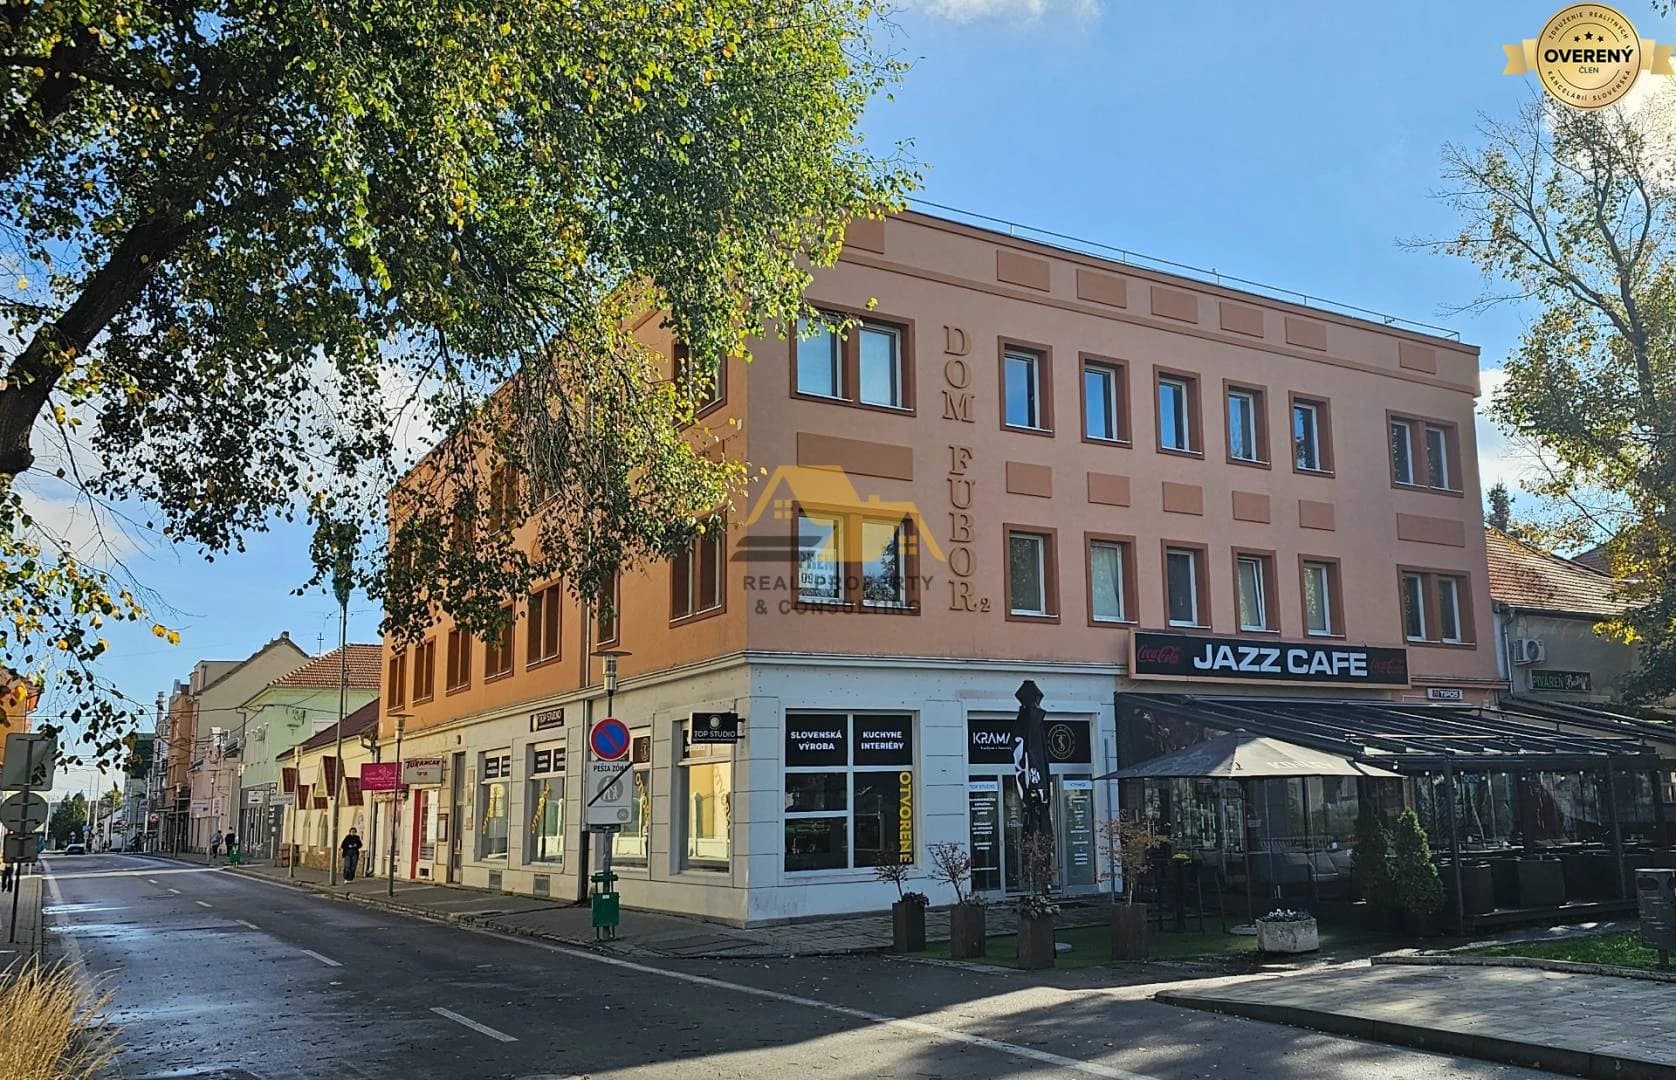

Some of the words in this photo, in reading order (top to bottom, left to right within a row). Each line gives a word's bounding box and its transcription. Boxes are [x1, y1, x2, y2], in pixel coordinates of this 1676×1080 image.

[942, 324, 976, 423] DOM
[947, 445, 977, 612] FUBOR
[1193, 643, 1281, 673] JAZZ
[1287, 649, 1368, 677] CAFE
[790, 730, 842, 739] SLOVENSKÁ
[863, 731, 902, 739] KUCHYNE
[798, 742, 835, 751] VÝROBA
[861, 741, 904, 750] INTERIÉRY
[593, 763, 610, 772] PEŠIA
